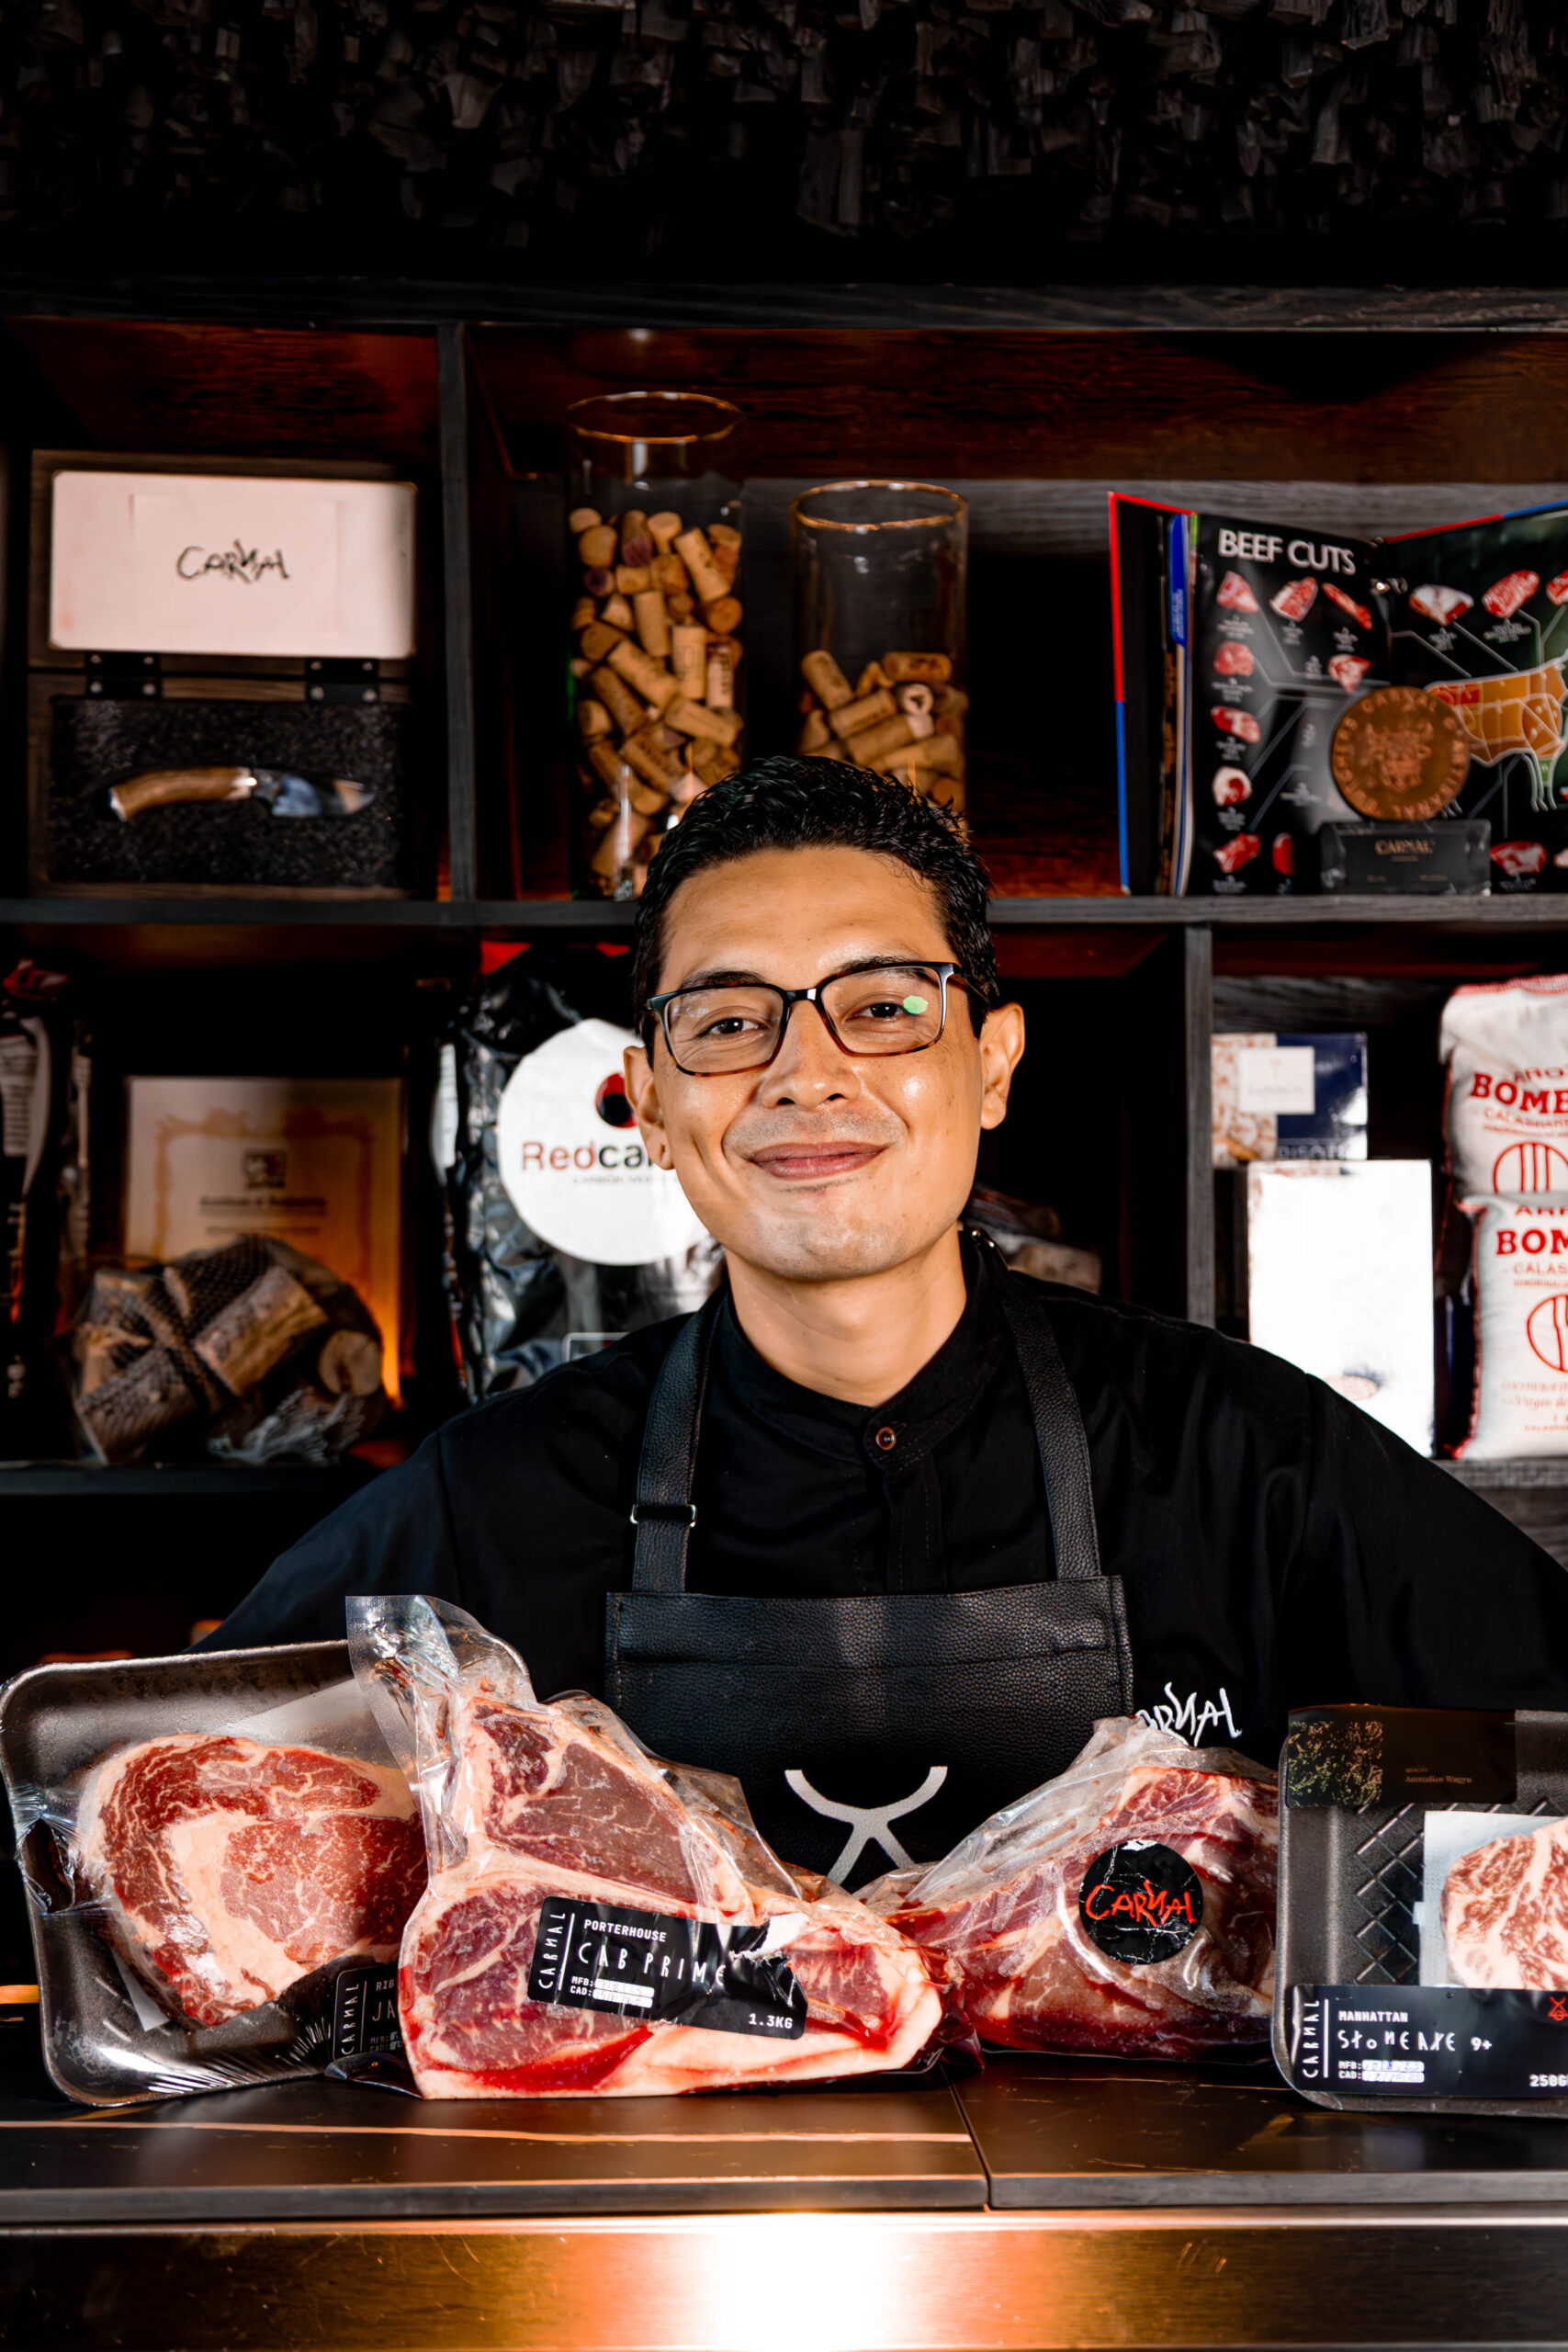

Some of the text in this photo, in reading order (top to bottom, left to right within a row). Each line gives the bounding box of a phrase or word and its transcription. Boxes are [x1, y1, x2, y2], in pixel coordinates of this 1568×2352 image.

[1218, 527, 1356, 575] BEEF CUTS
[522, 1139, 654, 1170] Redca
[583, 1919, 667, 1942] PORTERHOUSE
[578, 1942, 726, 1987] CAB PRIME
[376, 1979, 395, 1992] RIB
[749, 2013, 794, 2030] 1.3KG
[1338, 2010, 1408, 2022] MANHATTAN
[1471, 2036, 1493, 2052] 9+
[1338, 2070, 1361, 2080] CAD:
[1529, 2074, 1568, 2087] 250G
